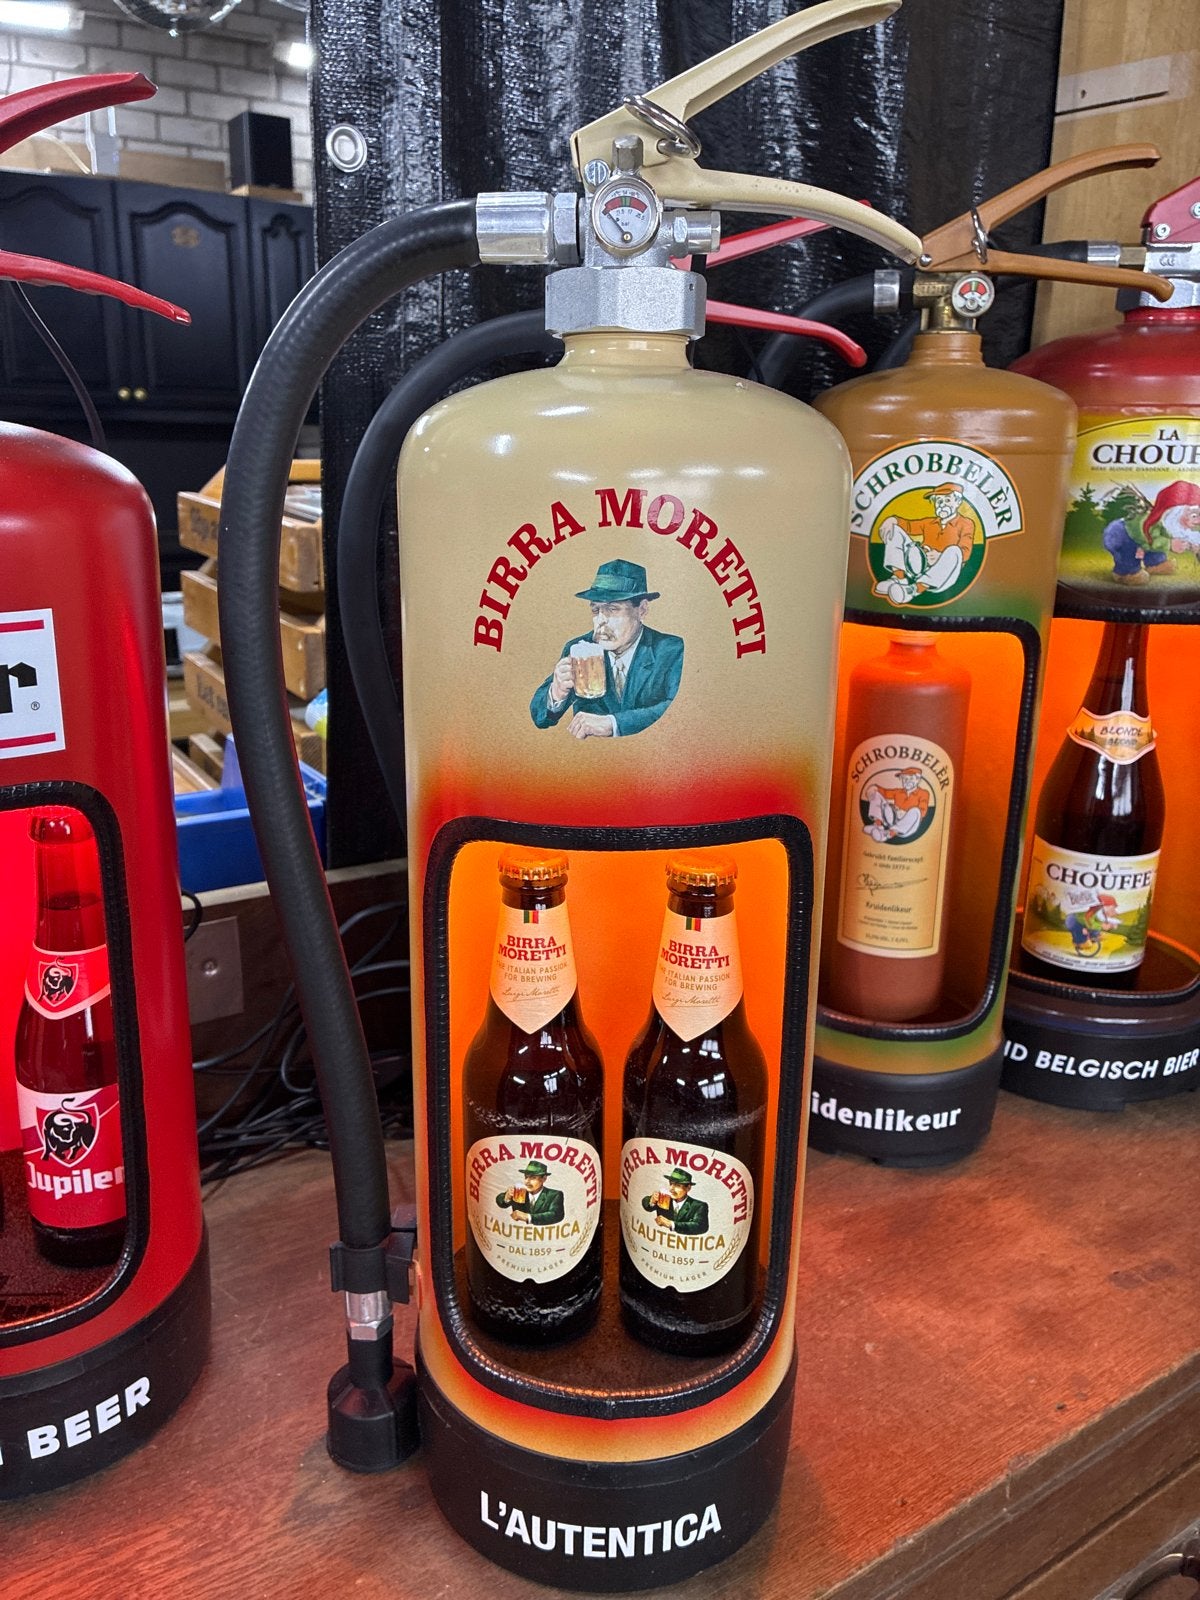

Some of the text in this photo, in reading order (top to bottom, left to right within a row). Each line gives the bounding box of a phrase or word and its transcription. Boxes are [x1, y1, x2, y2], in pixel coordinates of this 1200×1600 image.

[1158, 429, 1181, 441] LA
[473, 488, 766, 659] BIRRA MORETTI
[851, 745, 950, 792] SCHROBBELÈR
[1046, 863, 1152, 890] CHOUFFE
[1095, 862, 1112, 872] LA
[506, 934, 557, 949] BIRRA
[669, 939, 719, 957] BIRRA
[498, 943, 567, 961] MORETTI
[660, 947, 730, 969] MORETTI
[504, 972, 557, 983] FOR BREWING
[507, 965, 536, 974] ITALIAN
[540, 961, 568, 974] PASSION
[668, 970, 696, 982] ITALIAN
[699, 973, 730, 983] PASSION
[664, 976, 718, 991] FOR BREWING
[1034, 1050, 1159, 1080] BELGISCH
[1162, 1048, 1200, 1077] BIER
[469, 1141, 598, 1208] BIRRA MORETTI
[621, 1146, 748, 1225] BIRRA MORETTI
[483, 1215, 581, 1241] L'AUTENTICA
[631, 1216, 726, 1251] L'AUTENTICA
[509, 1246, 552, 1256] DAL 1859
[652, 1250, 695, 1266] DAL 1859
[497, 1255, 564, 1273] PREMIUM LAGER
[641, 1258, 708, 1283] PREMIUM LAGER
[27, 1376, 151, 1460] BEER
[480, 1490, 722, 1558] L'AUTENTICA
